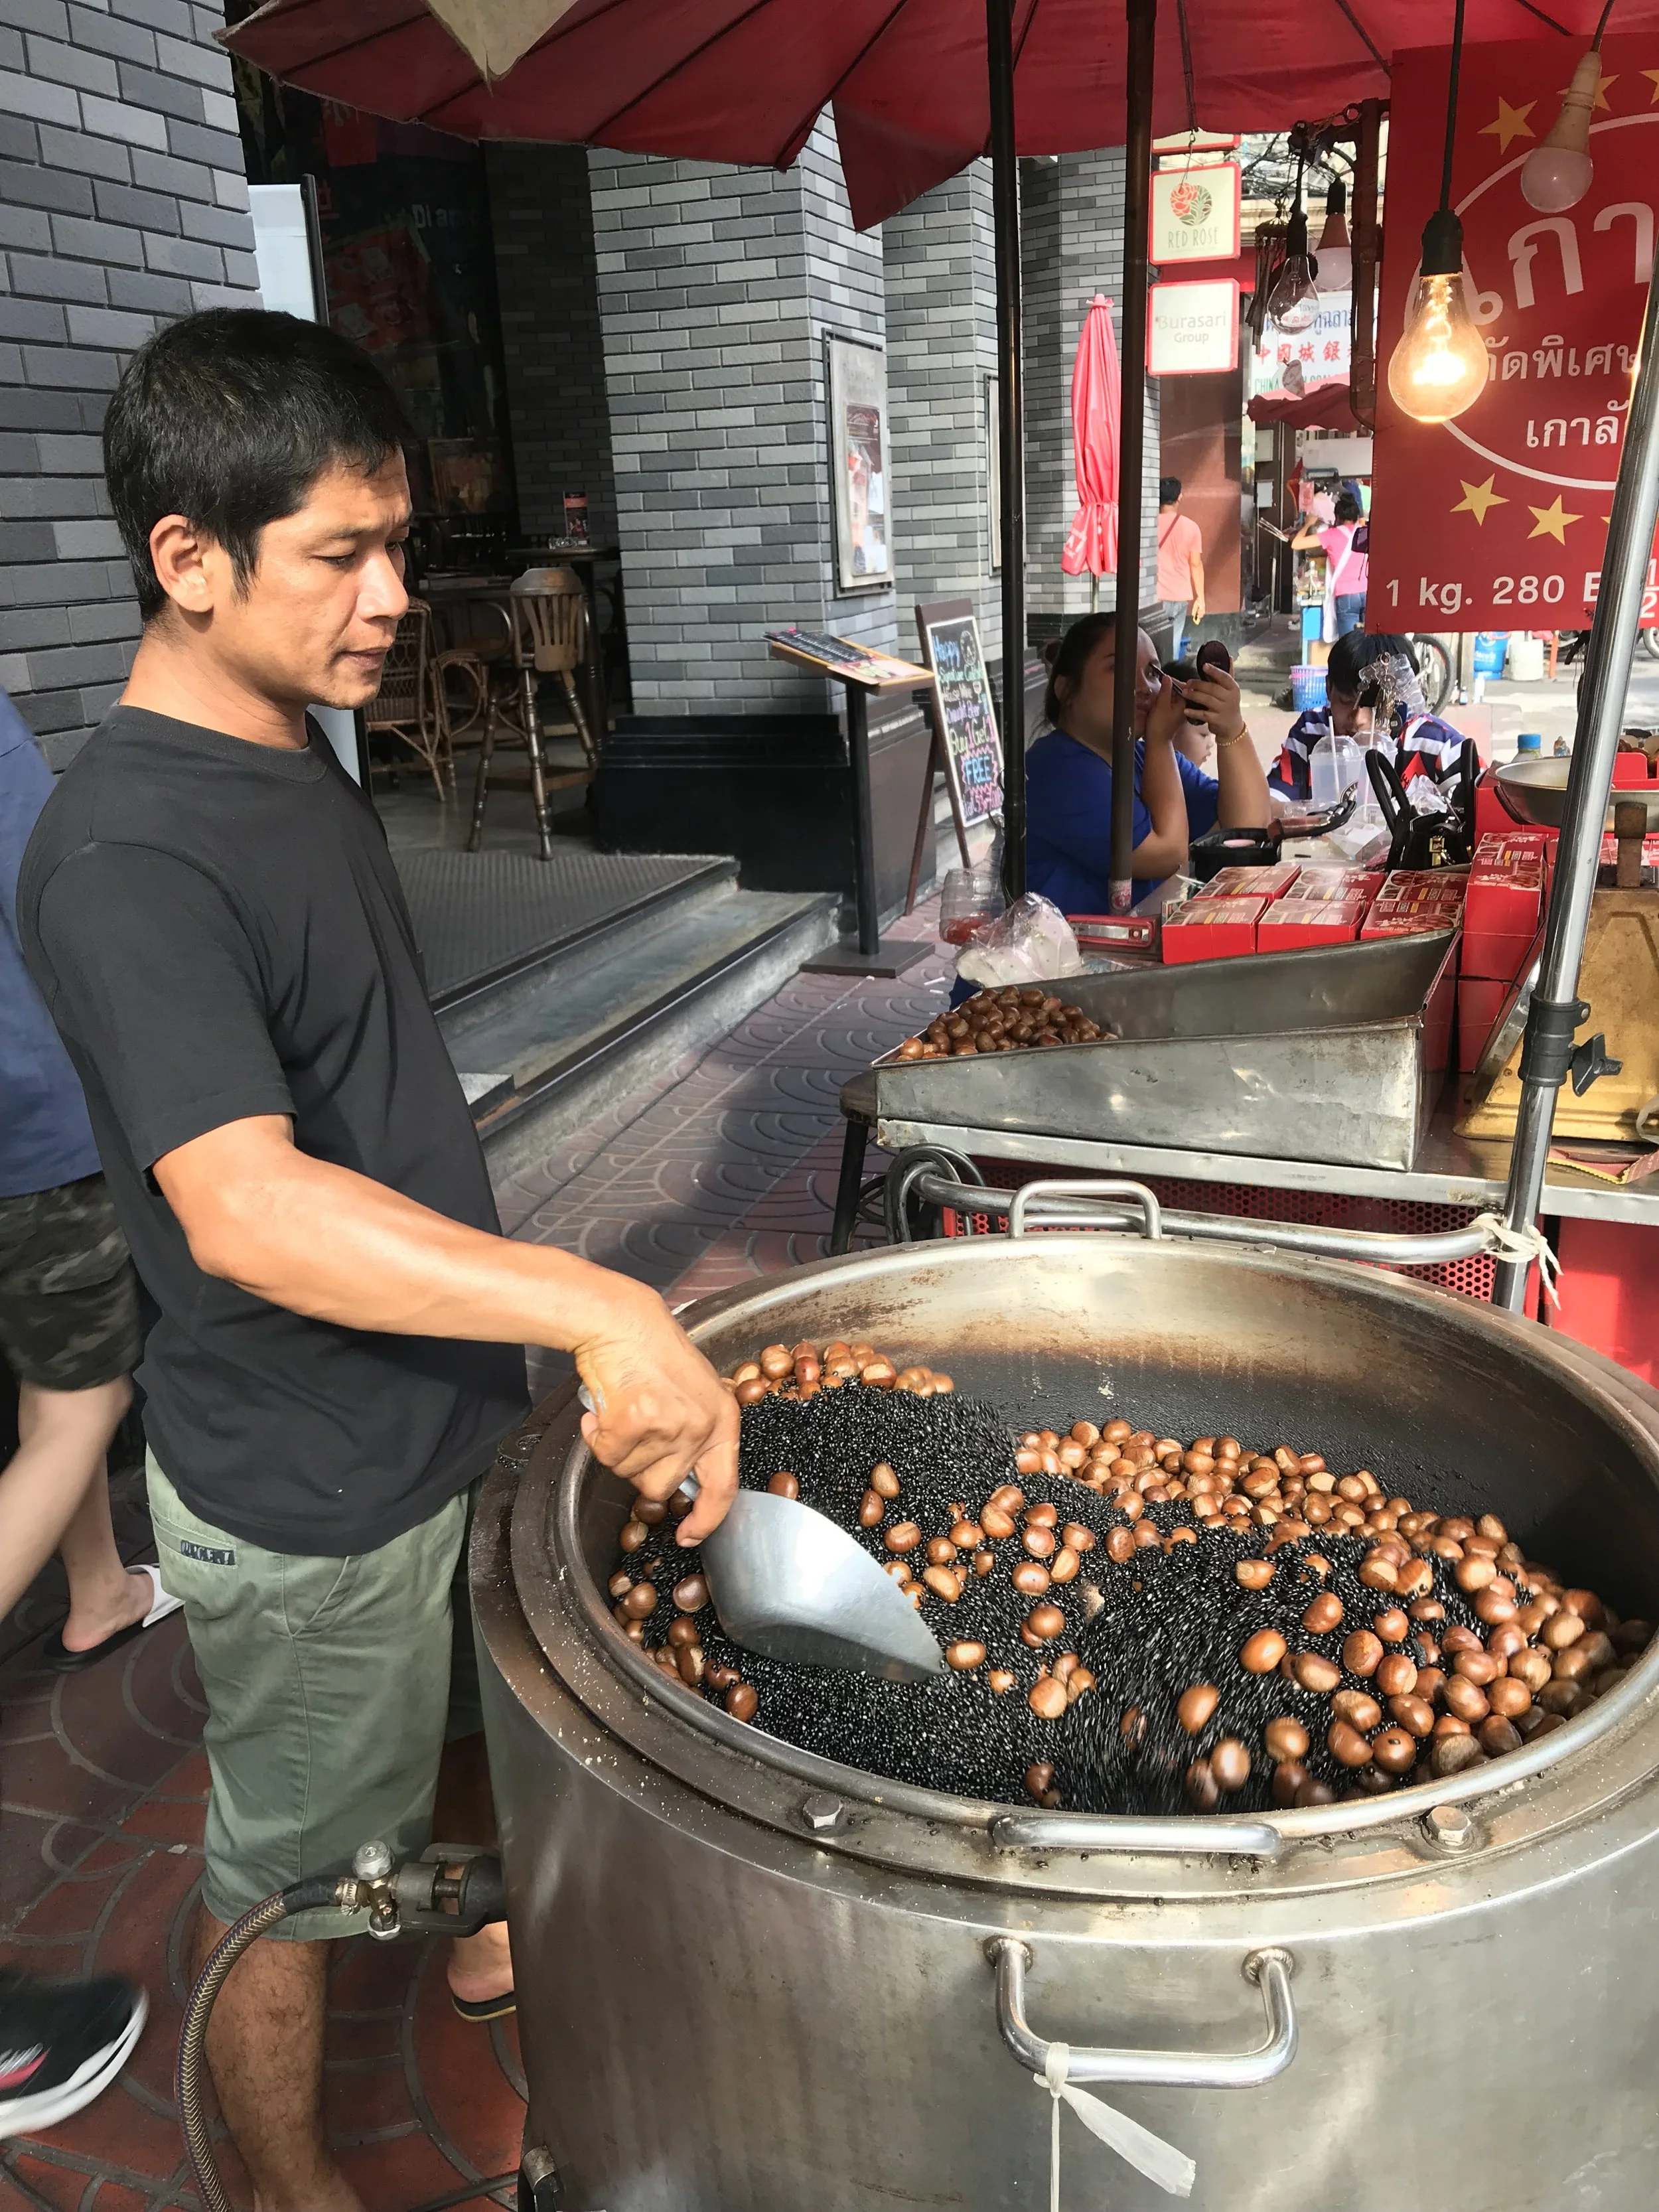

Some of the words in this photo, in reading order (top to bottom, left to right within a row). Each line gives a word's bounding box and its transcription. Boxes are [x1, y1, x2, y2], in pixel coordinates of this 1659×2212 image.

[1168, 230, 1188, 248] RED
[1192, 227, 1218, 246] ROSE
[1158, 311, 1226, 330] Burasari
[1173, 332, 1209, 344] Group
[1386, 579, 1399, 607] 1
[1419, 577, 1473, 615] kg.
[1492, 575, 1565, 605] 280
[932, 634, 961, 668] Happy
[949, 728, 968, 755] Buy
[965, 721, 975, 749] 1
[972, 717, 990, 747] Get
[986, 715, 996, 743] 1
[965, 755, 993, 786] FREE
